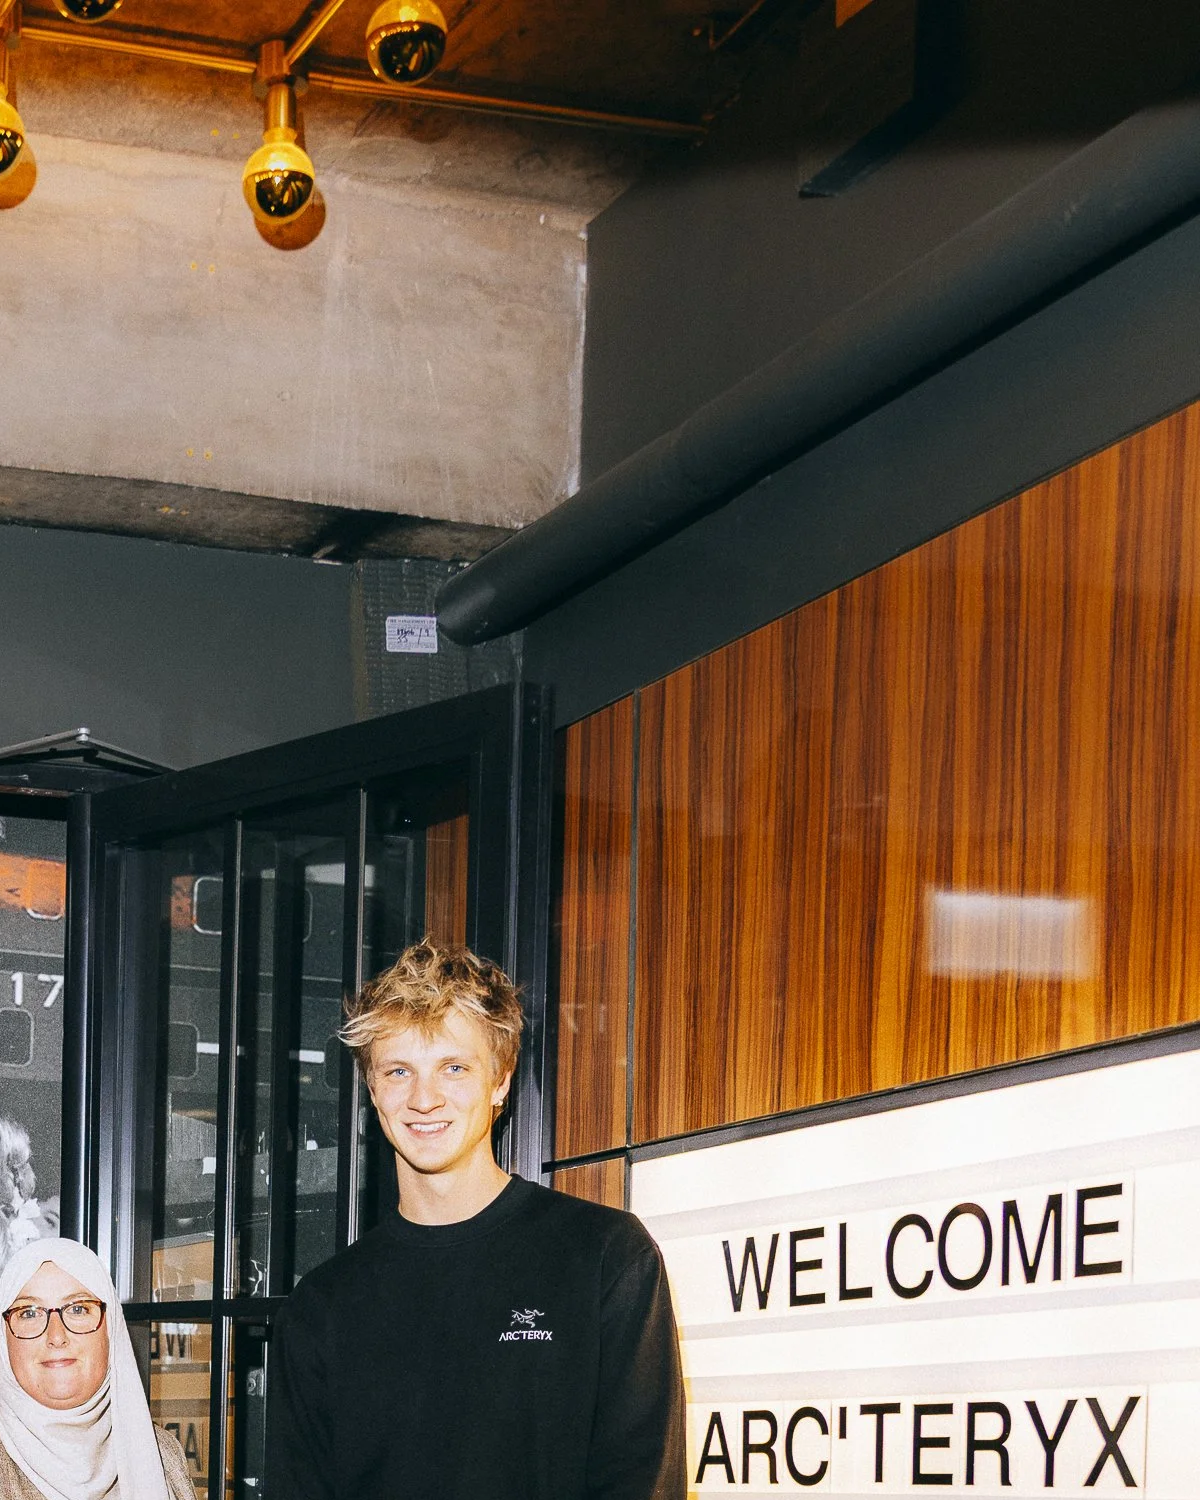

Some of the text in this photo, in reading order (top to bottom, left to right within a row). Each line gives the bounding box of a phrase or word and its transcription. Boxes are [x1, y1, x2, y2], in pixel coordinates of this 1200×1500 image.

[11, 971, 64, 1008] 17
[721, 1182, 1123, 1313] WELCOME
[498, 1329, 553, 1342] ARC'TERYX
[694, 1395, 1142, 1488] ARC'TERYX
